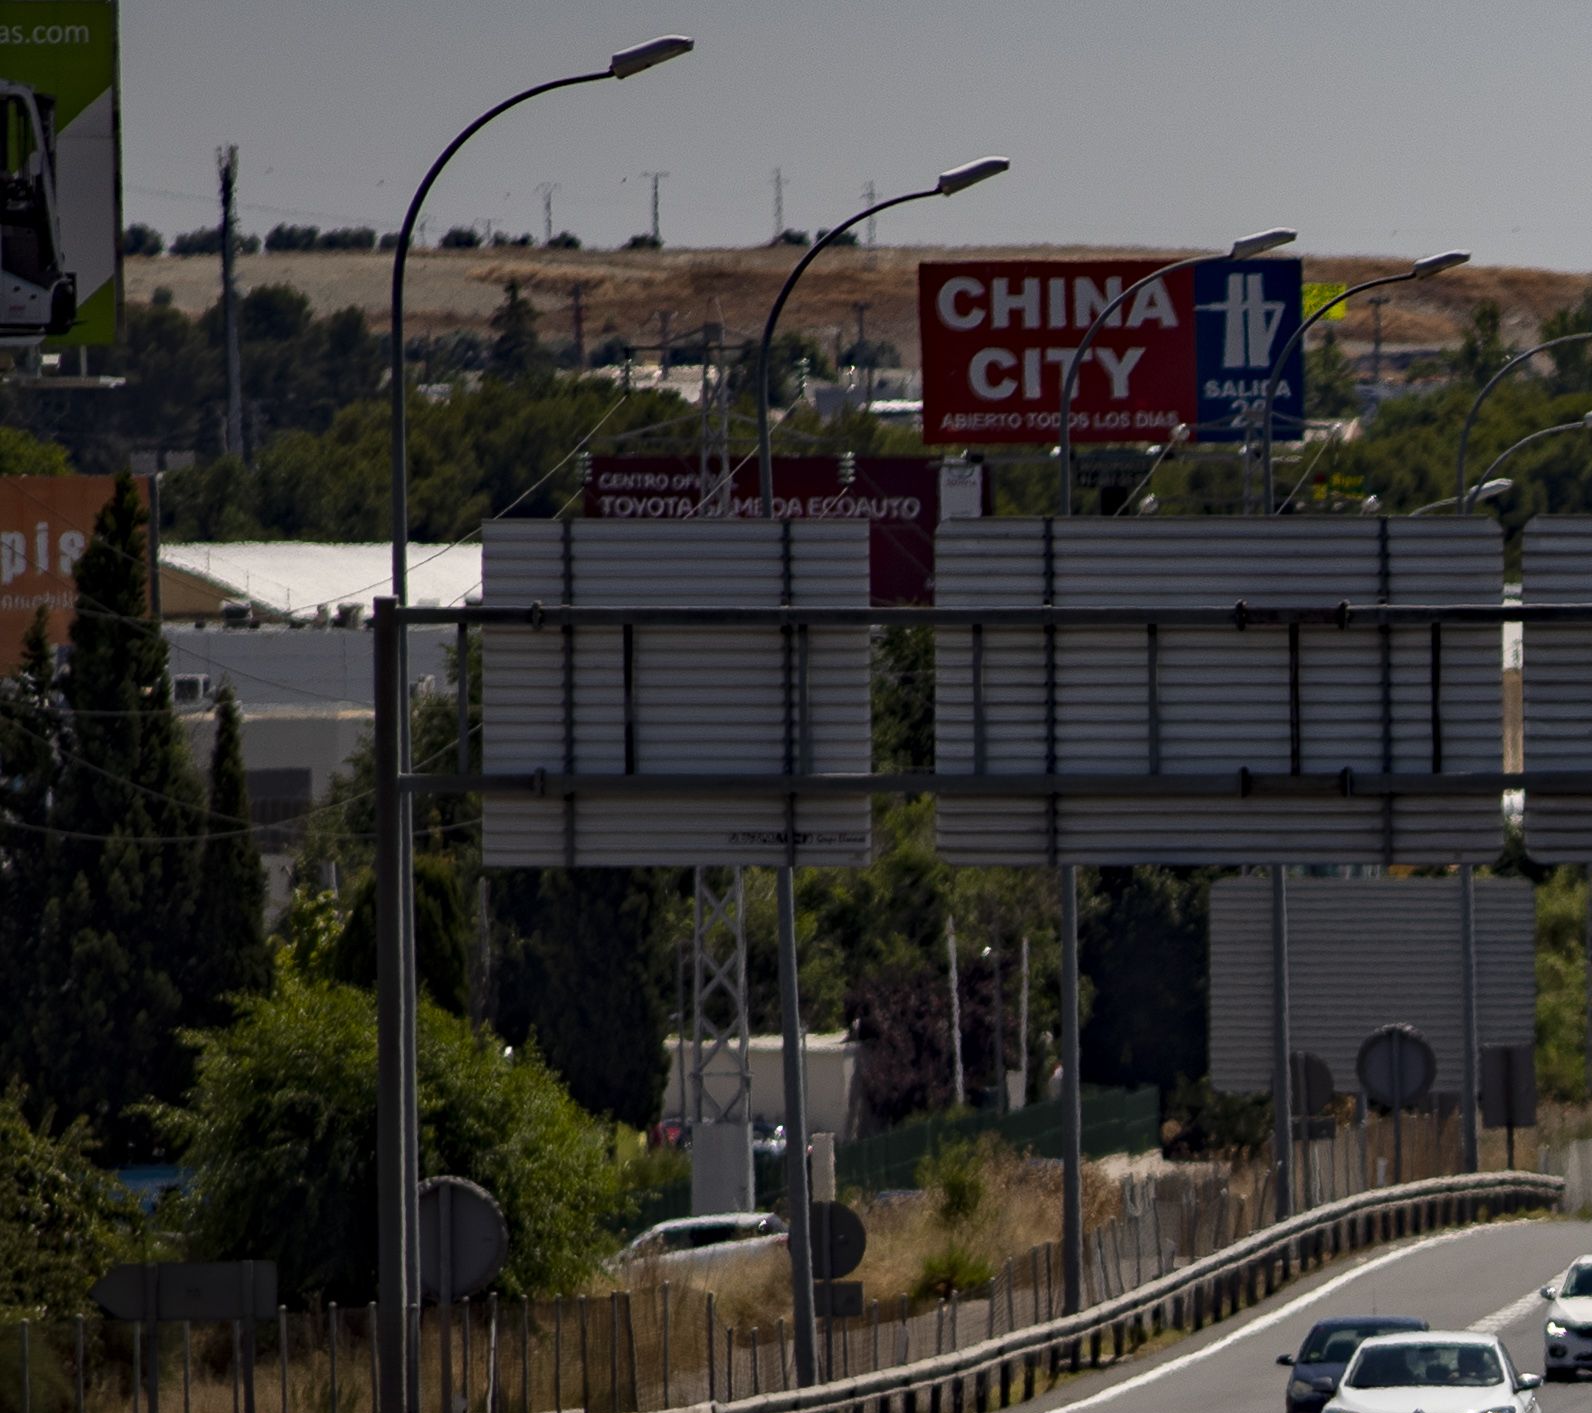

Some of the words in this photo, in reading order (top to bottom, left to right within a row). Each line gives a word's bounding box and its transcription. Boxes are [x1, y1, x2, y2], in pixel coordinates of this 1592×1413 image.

[935, 276, 1180, 331] CHINA
[967, 346, 1147, 401] CITY
[1204, 379, 1291, 398] SALIDA
[939, 411, 1022, 431] ABIERTO
[1024, 411, 1089, 431] TODOS
[1094, 411, 1133, 431] LOS
[599, 472, 669, 492] CENTRO
[601, 496, 693, 519] TOYOTA
[808, 495, 921, 519] ECOAUTO
